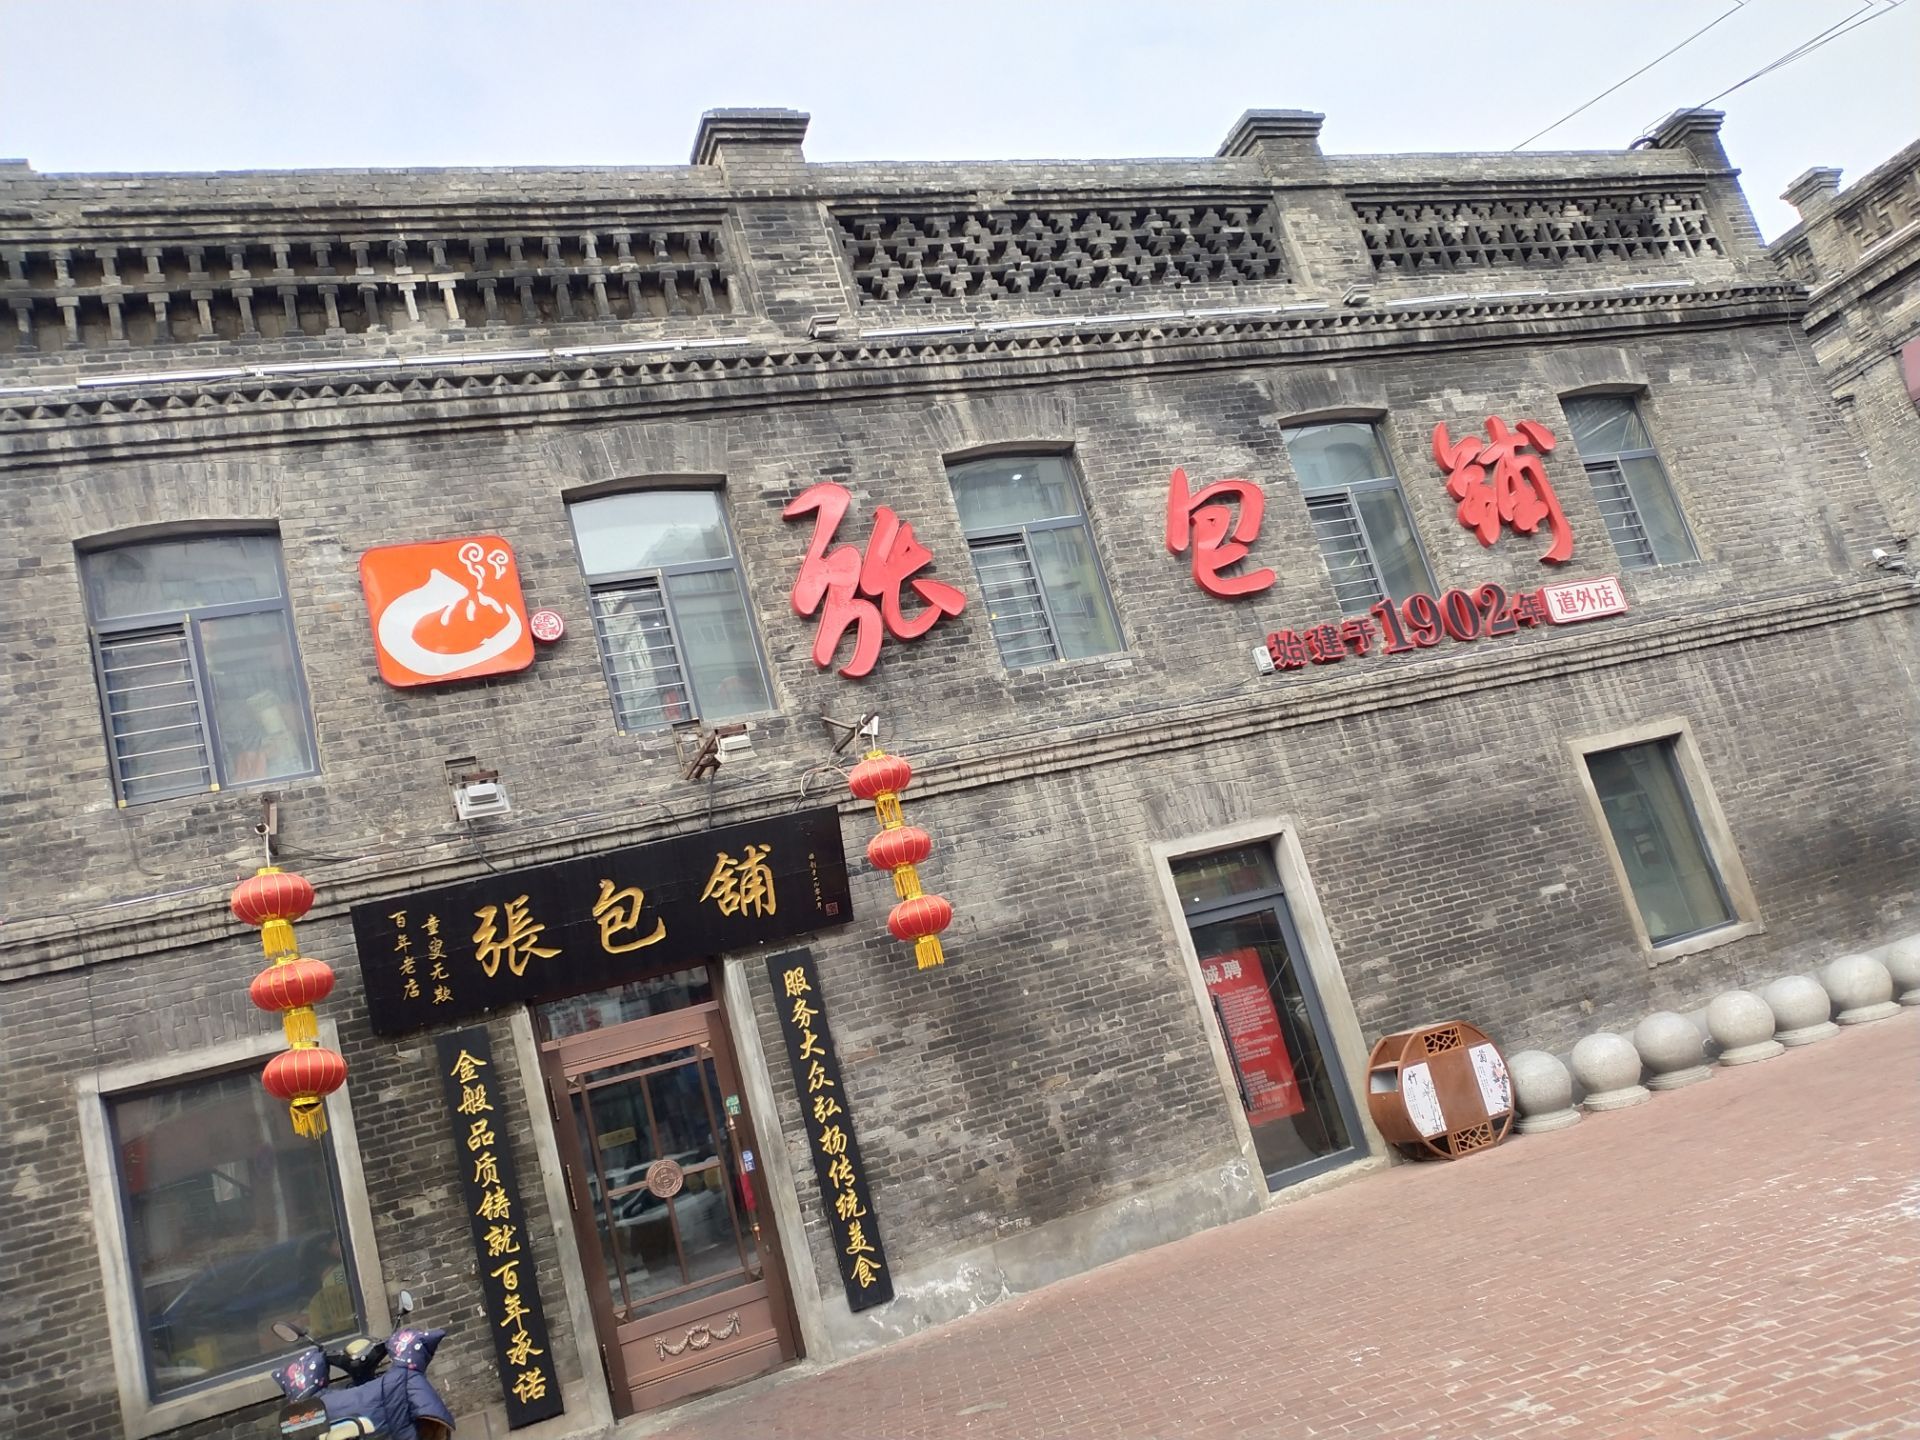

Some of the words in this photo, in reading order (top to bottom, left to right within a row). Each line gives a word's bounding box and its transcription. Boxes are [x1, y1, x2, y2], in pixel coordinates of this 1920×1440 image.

[1267, 583, 1547, 670] 始建于1902年
[1553, 576, 1617, 615] 道外店
[388, 910, 420, 1001] 百年老店
[421, 913, 454, 1005] 童叟无欺
[783, 967, 882, 1288] 服务大众弘扬传统美食
[450, 1049, 547, 1404] 金般品质铸就百年承诺
